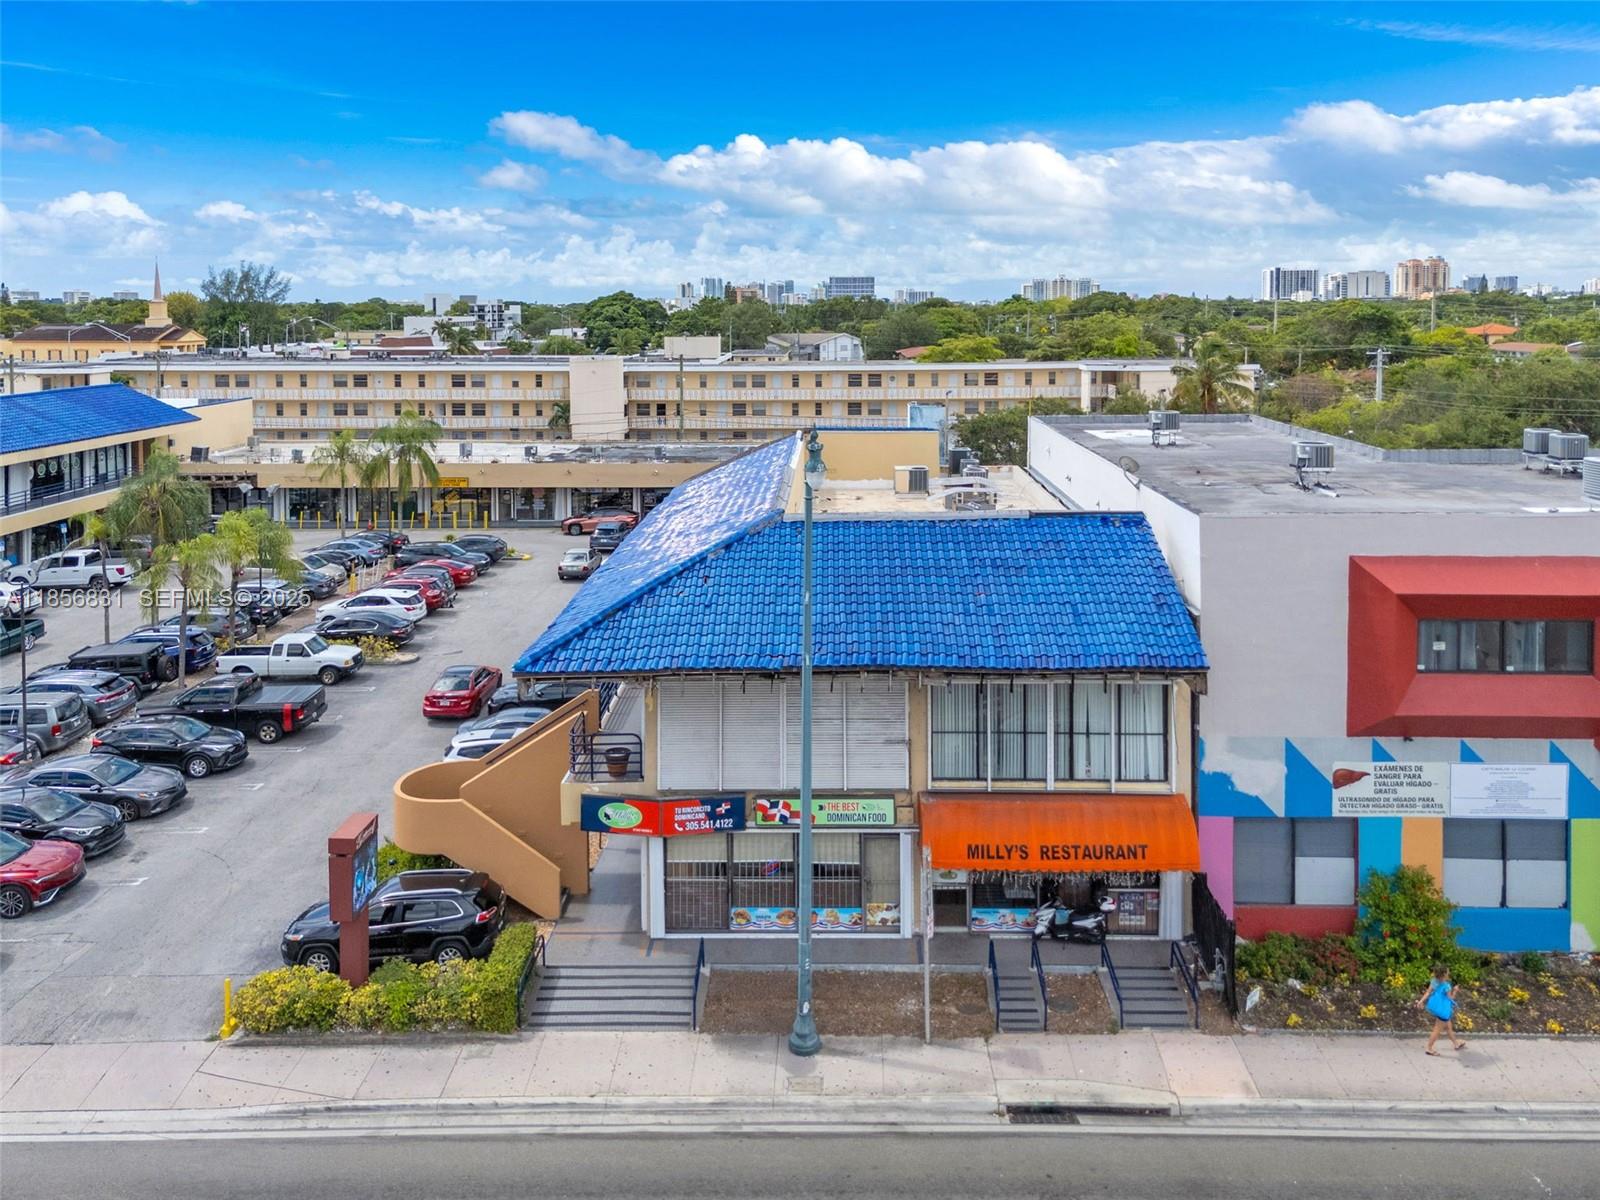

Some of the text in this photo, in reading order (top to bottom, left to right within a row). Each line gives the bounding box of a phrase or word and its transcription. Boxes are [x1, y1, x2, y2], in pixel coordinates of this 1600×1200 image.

[827, 802, 860, 811] THE BEST
[827, 813, 887, 822] DOMINICAN FOOD
[685, 818, 733, 830] 305.541.4122
[967, 844, 1148, 860] MILLY'S RESTAURANT
